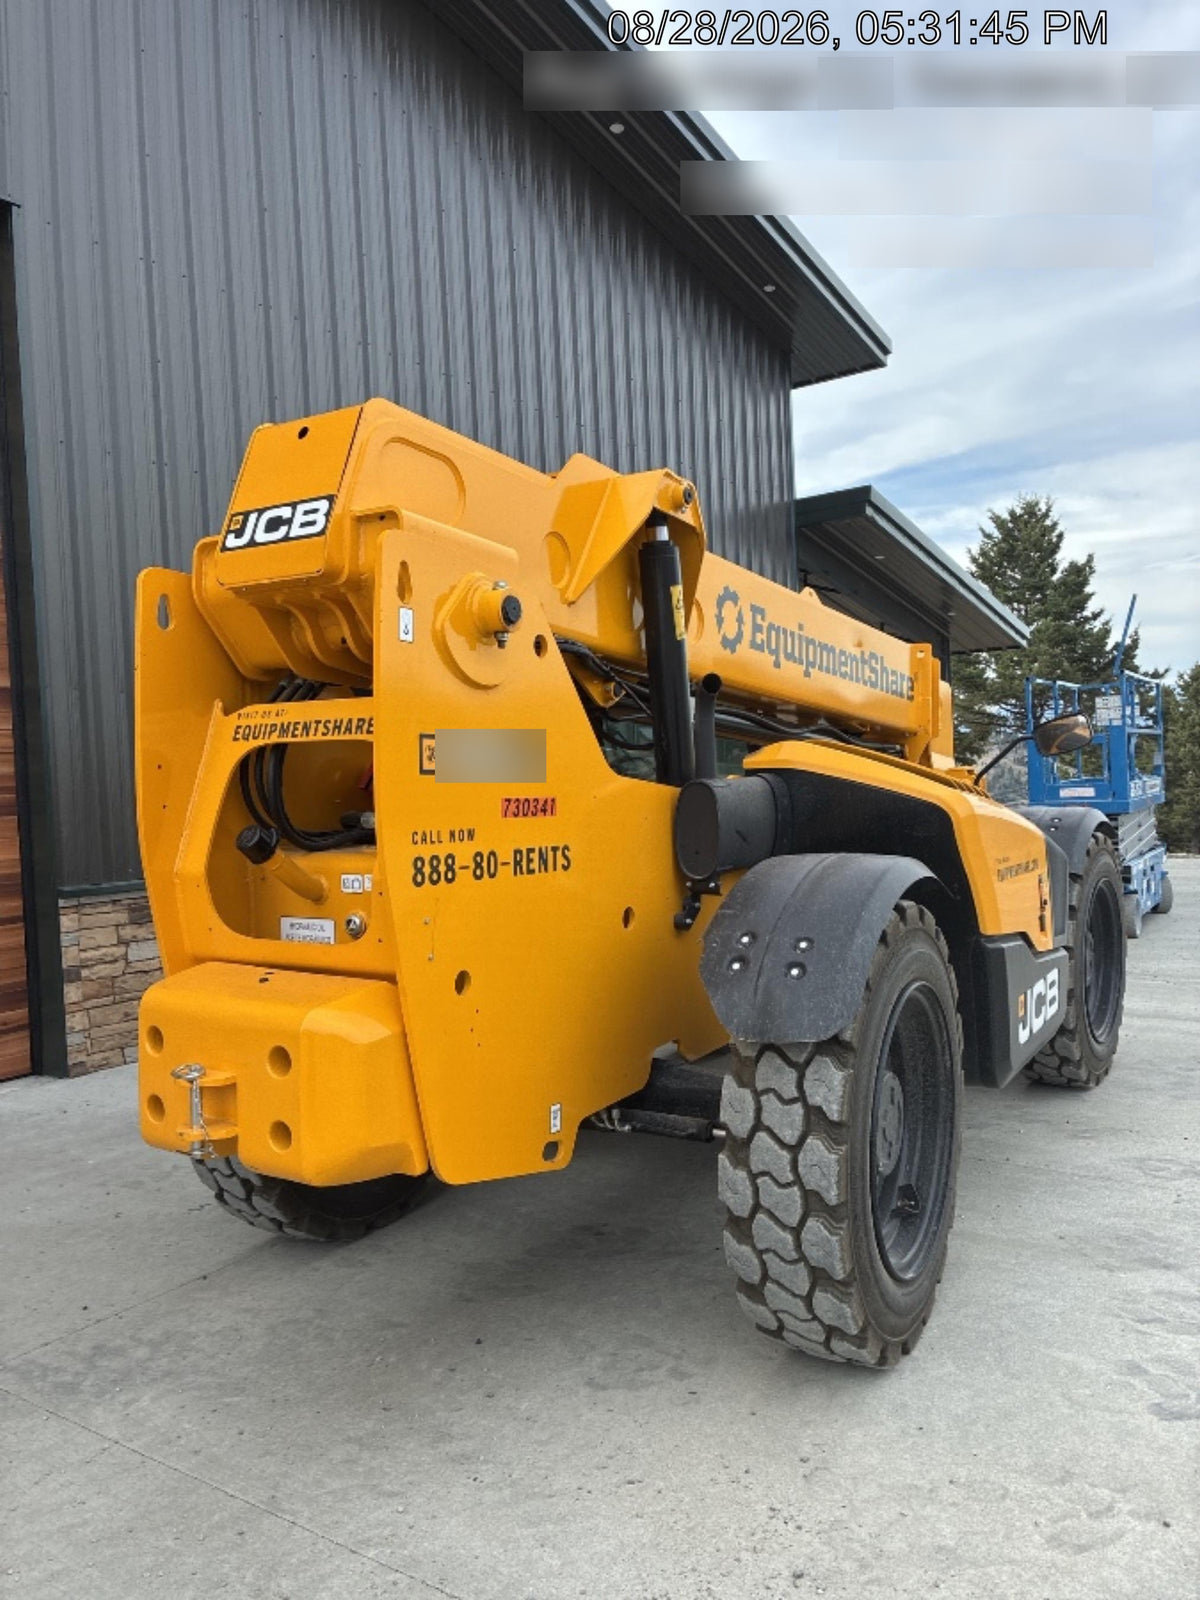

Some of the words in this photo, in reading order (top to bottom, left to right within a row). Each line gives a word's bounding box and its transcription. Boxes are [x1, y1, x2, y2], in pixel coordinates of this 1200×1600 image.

[225, 499, 330, 548] JCB
[749, 603, 914, 703] EquipmentShare
[503, 797, 556, 818] 730341
[411, 830, 443, 845] CALL
[449, 828, 476, 843] NOW
[411, 844, 572, 888] 888-80-RENTS
[1018, 966, 1059, 1045] JCB
